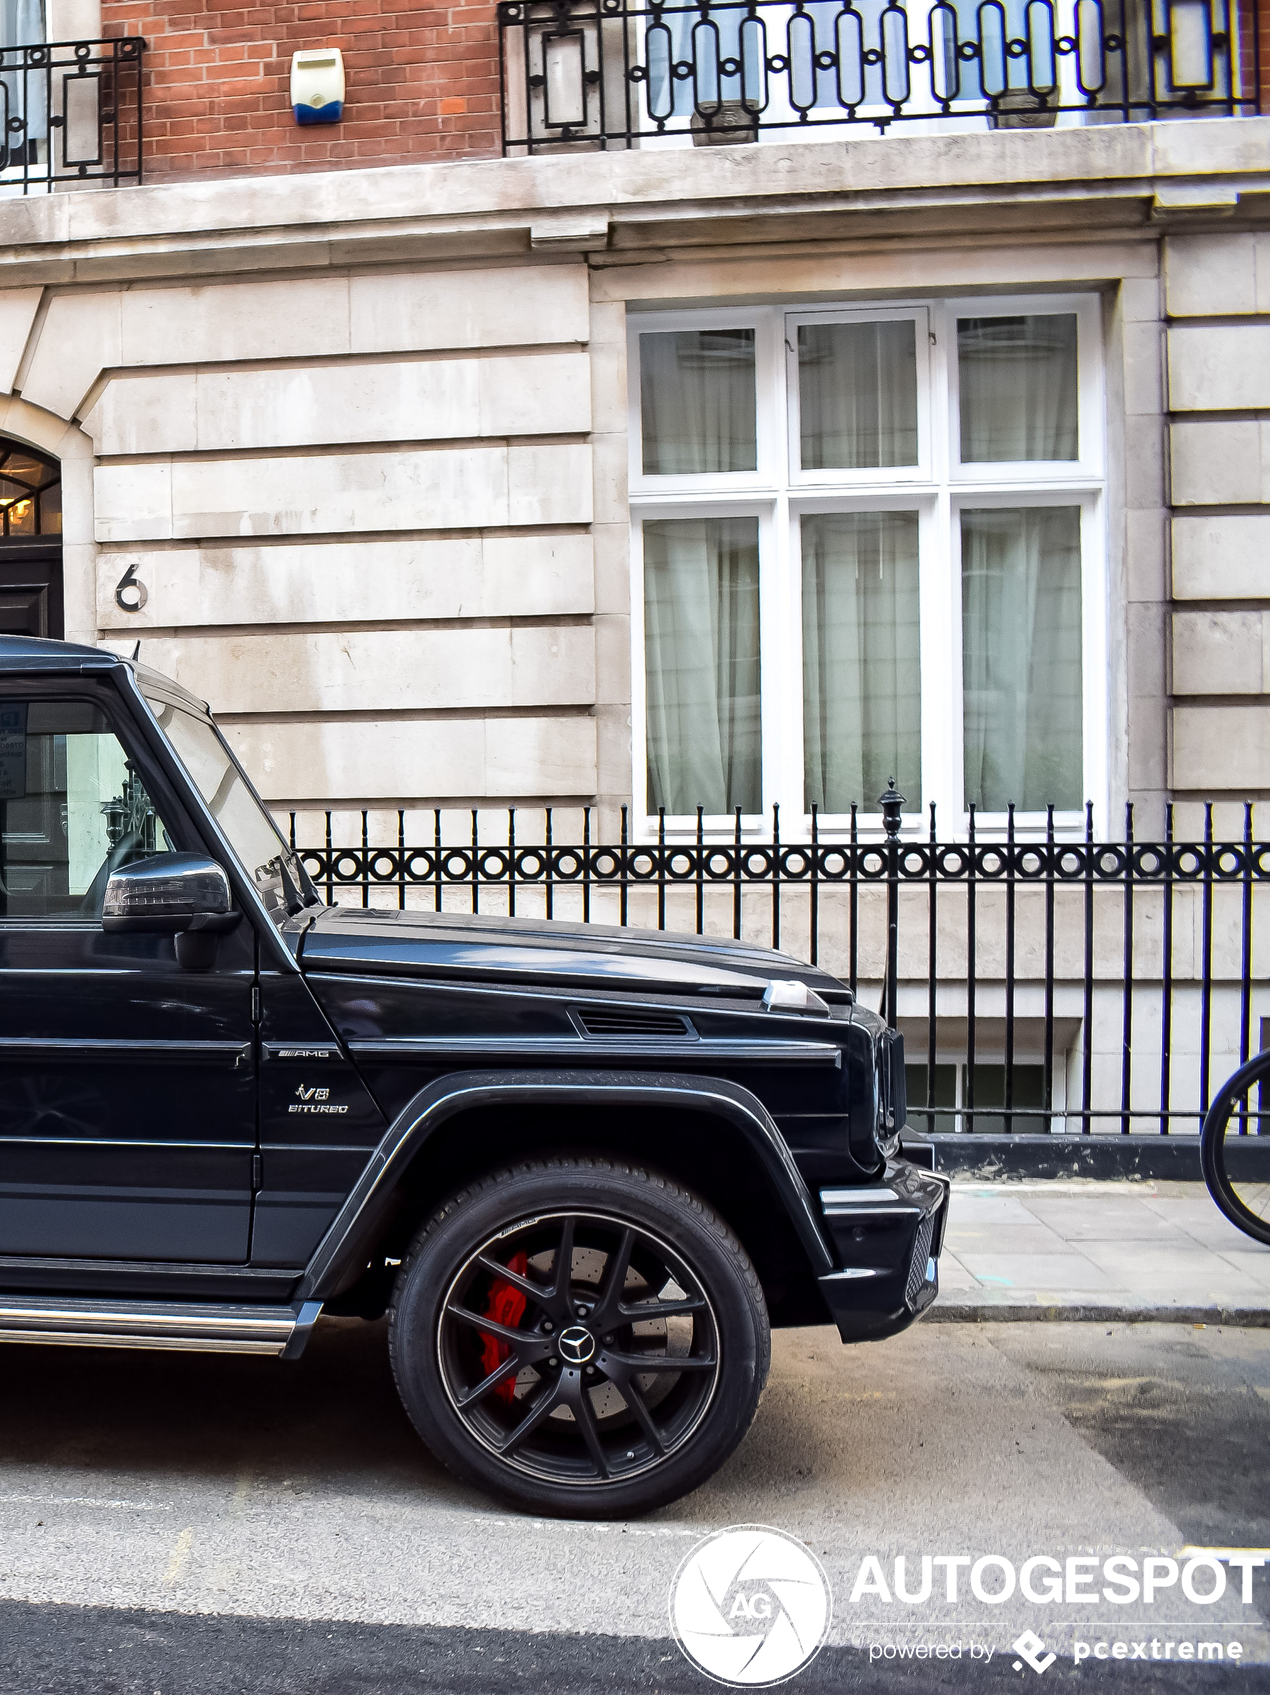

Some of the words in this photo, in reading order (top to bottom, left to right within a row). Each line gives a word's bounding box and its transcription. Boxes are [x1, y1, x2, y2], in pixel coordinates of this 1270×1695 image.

[114, 564, 148, 612] 6
[291, 1050, 330, 1058] AMG
[295, 1084, 330, 1101] V8
